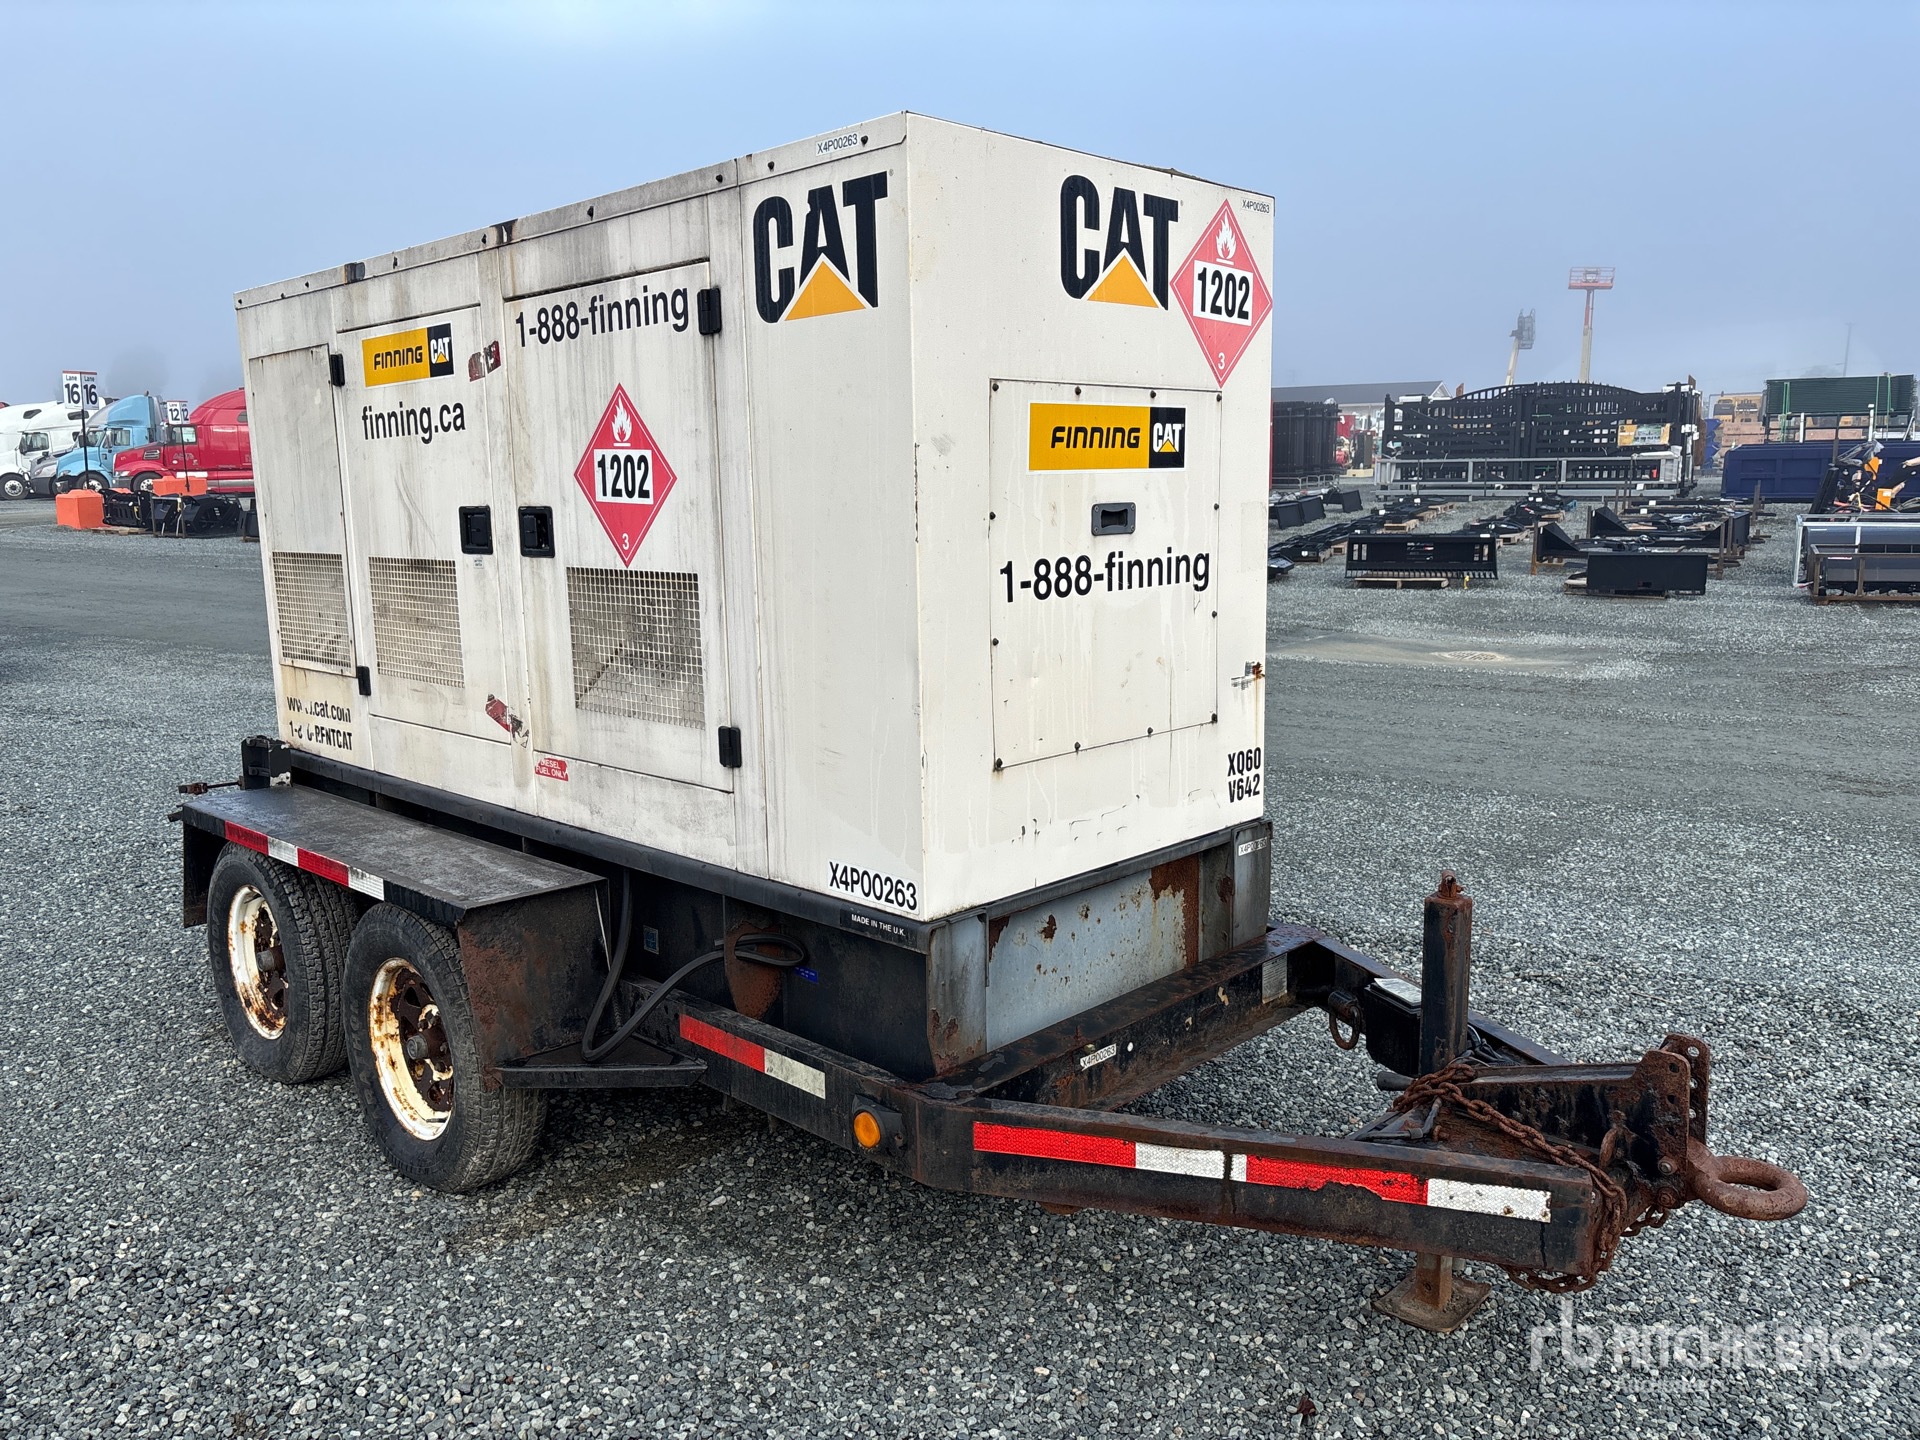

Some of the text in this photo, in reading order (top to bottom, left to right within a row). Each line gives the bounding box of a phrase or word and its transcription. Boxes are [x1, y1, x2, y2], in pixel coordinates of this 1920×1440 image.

[817, 134, 858, 155] X4P00263
[1242, 200, 1270, 213] X4P00263
[753, 171, 888, 323] CAT
[1060, 175, 1178, 310] CAT
[1197, 267, 1250, 320] 1202
[515, 285, 689, 347] 1-888-finning
[374, 346, 423, 370] FINNING
[430, 338, 450, 364] CAT
[1217, 352, 1226, 370] 3
[64, 383, 80, 404] 16
[83, 384, 97, 405] 16
[169, 408, 180, 421] 12
[182, 408, 189, 421] 12
[362, 401, 465, 444] finning.ca
[1051, 426, 1141, 449] FINNING
[1153, 422, 1183, 453] CAT
[597, 454, 650, 499] 1202
[622, 533, 629, 550] 3
[1000, 547, 1210, 603] 1-888-finning
[287, 696, 351, 723] ww.cat.com
[536, 765, 567, 779] FUEL ONLY
[540, 760, 561, 770] DIESEL
[1227, 747, 1261, 776] XQ60
[1228, 773, 1260, 803] V642
[829, 861, 918, 911] X4P00263
[851, 913, 906, 937] MADE IN THE U.K.
[1082, 1045, 1115, 1067] X4P00263
